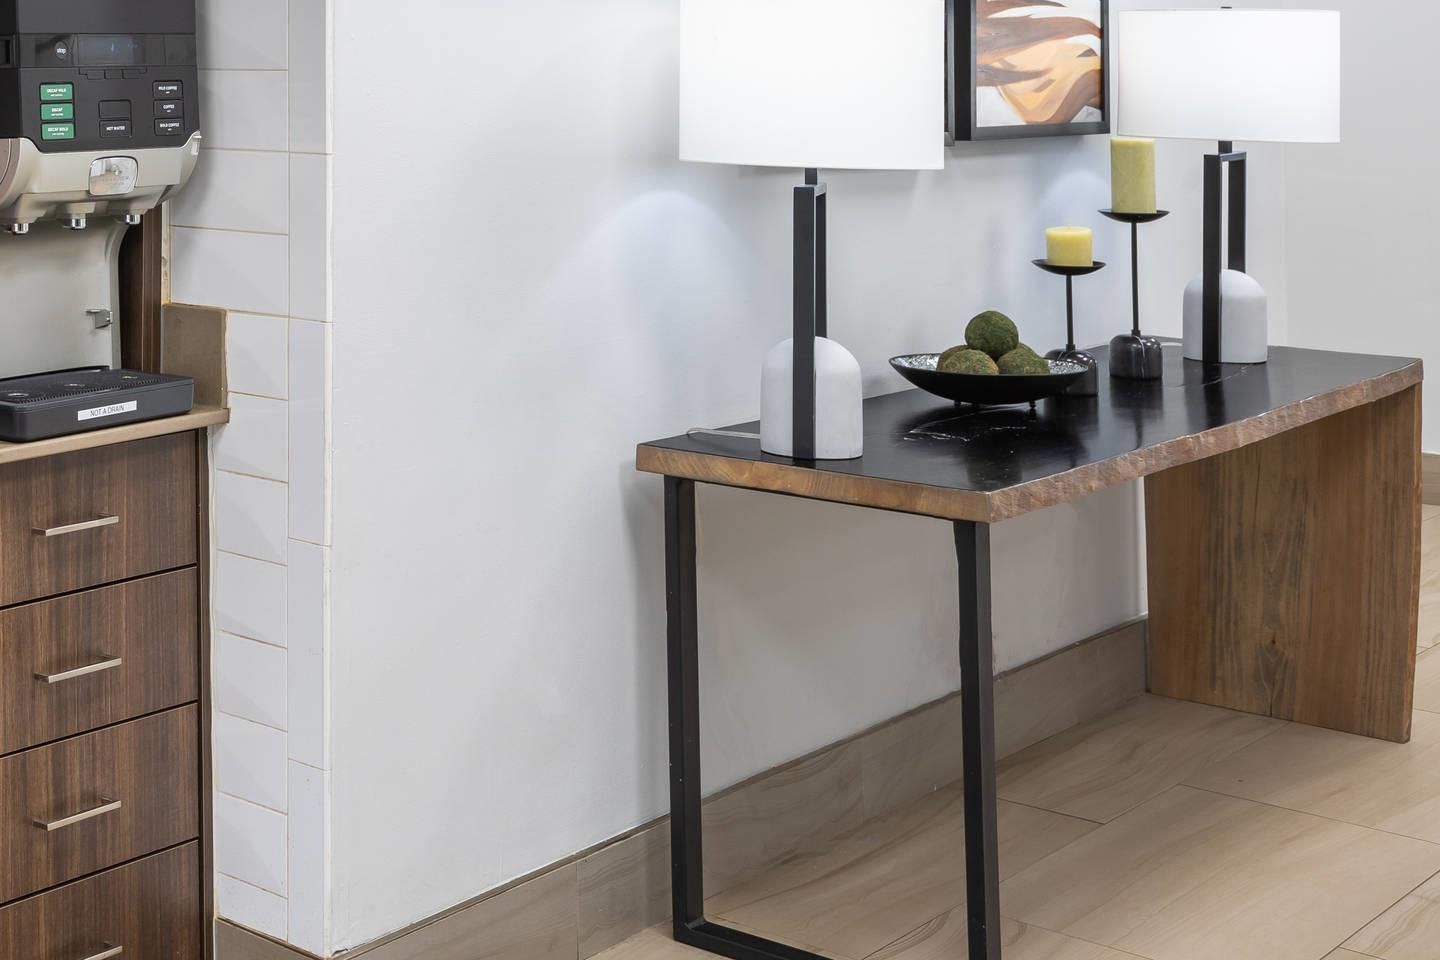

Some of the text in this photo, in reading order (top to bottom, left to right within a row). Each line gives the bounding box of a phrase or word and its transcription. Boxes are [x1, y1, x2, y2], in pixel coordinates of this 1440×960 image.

[90, 404, 124, 417] NOT A DRAIN
